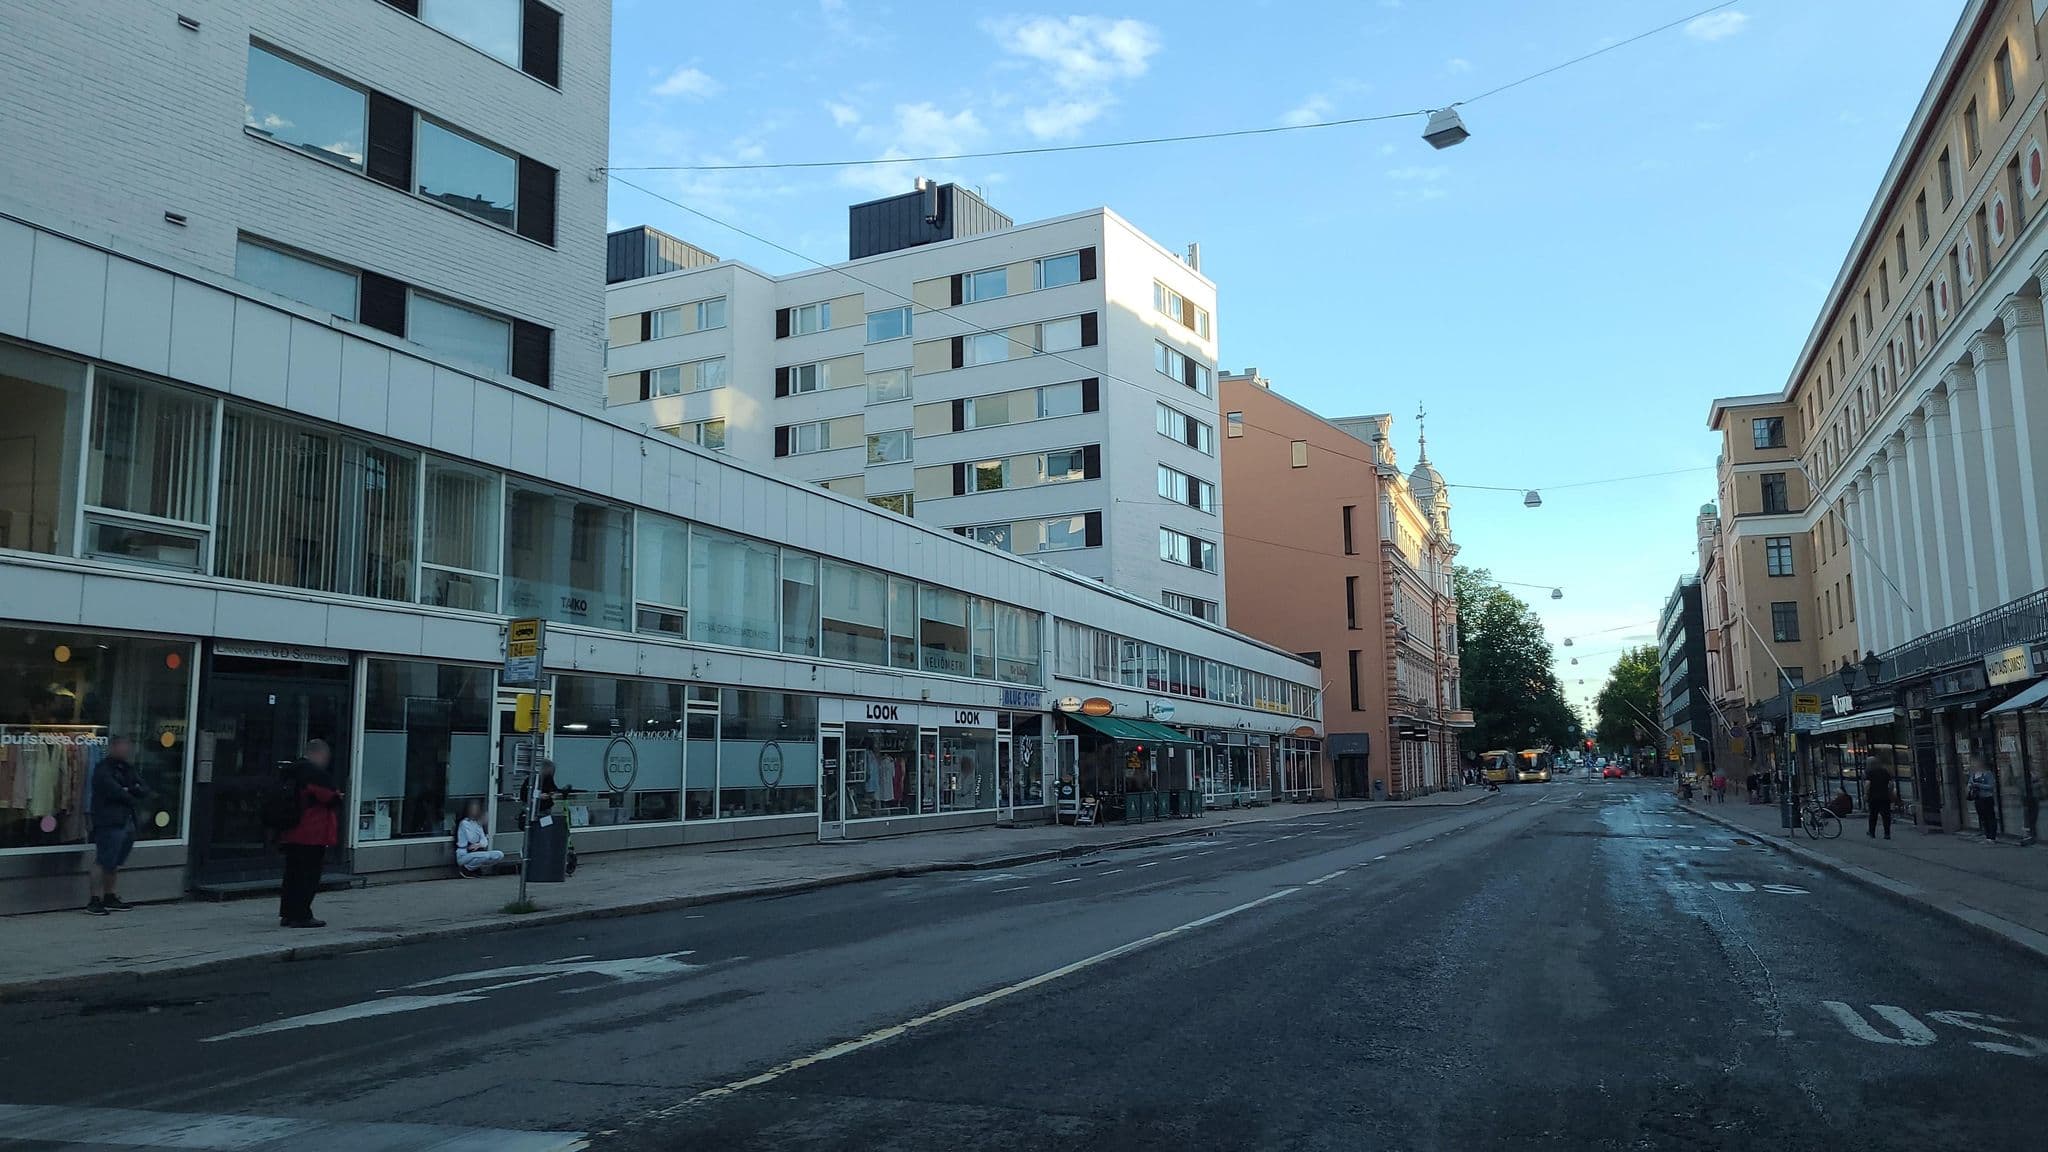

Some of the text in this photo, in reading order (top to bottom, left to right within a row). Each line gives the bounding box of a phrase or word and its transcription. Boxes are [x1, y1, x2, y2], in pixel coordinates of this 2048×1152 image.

[560, 596, 587, 612] TAIKO
[924, 655, 965, 673] NELIÖMETRI
[1004, 690, 1022, 705] BLUE
[866, 704, 898, 720] LOOK
[955, 711, 980, 724] LOOK
[1, 732, 108, 746] pufstore.com
[609, 763, 632, 773] OLO
